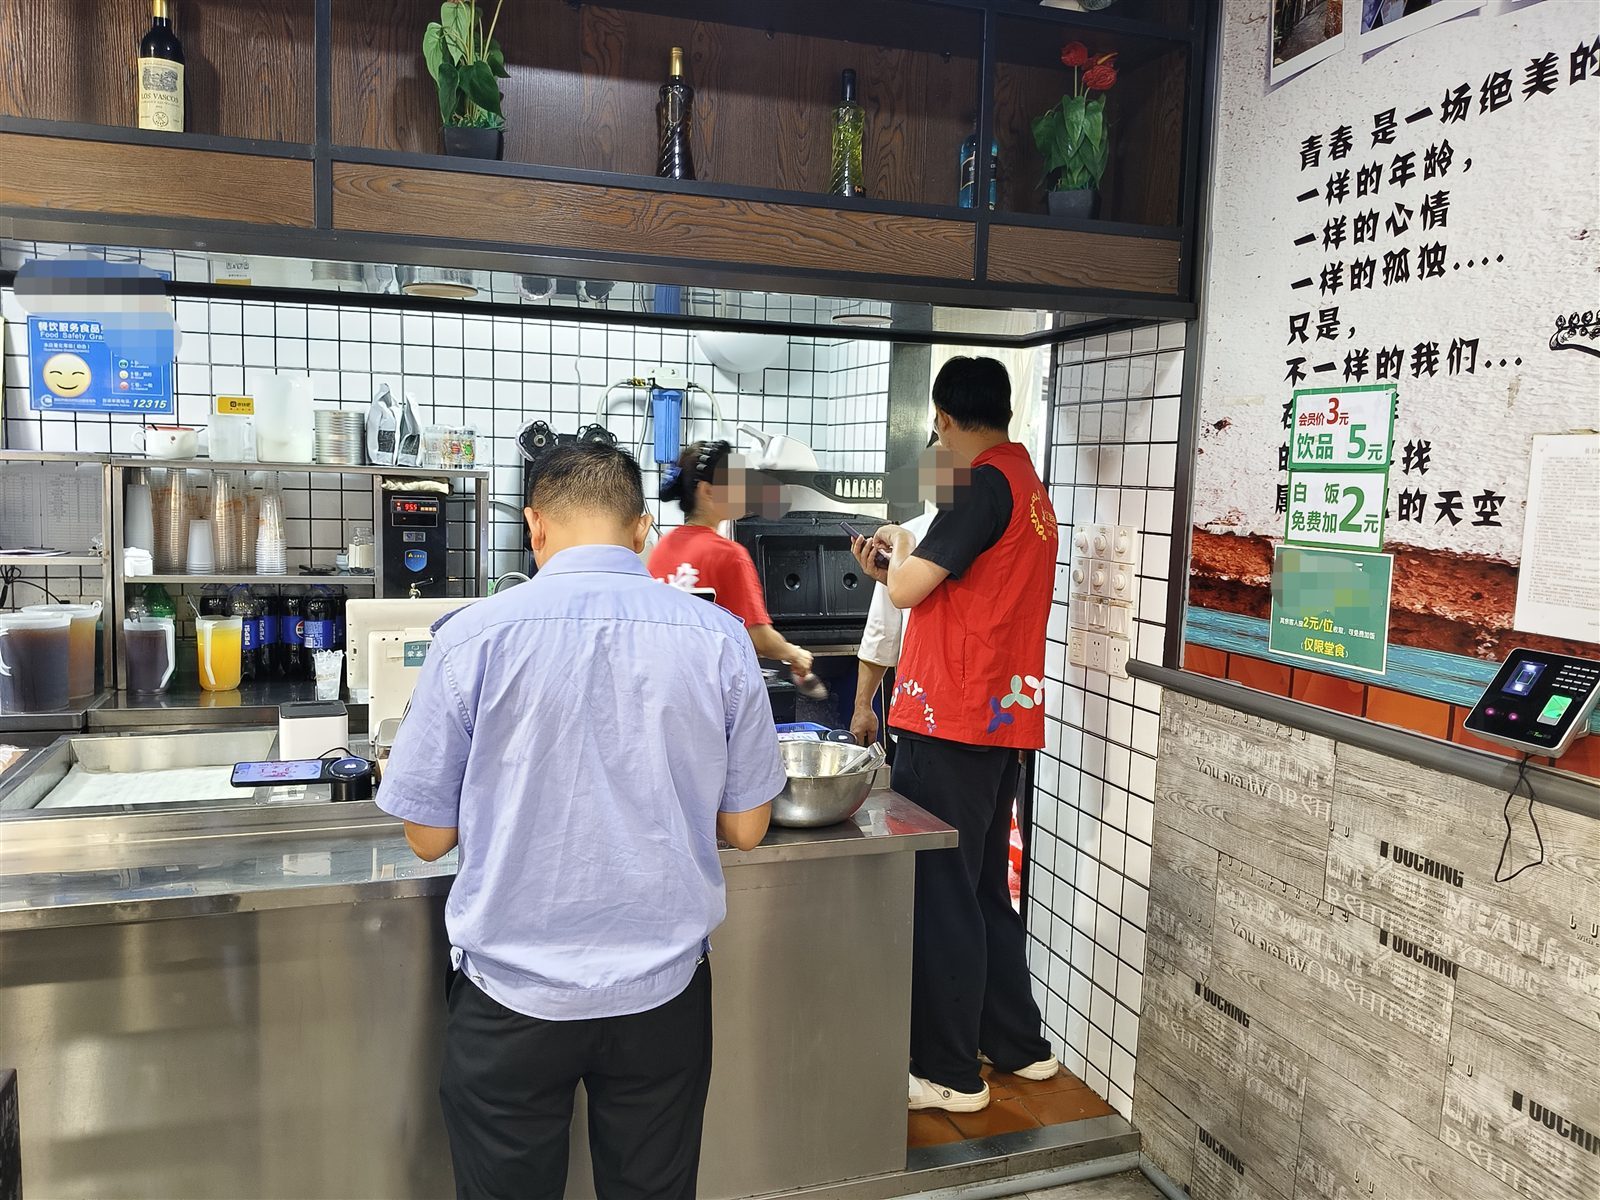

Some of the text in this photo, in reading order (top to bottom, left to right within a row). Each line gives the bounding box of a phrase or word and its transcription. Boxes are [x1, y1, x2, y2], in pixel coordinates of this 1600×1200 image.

[153, 93, 179, 104] VASCOS
[1299, 36, 1600, 171] 青春 是一场绝美的
[1294, 190, 1451, 251] 一样的心情
[38, 321, 104, 334] 餐饮服务食品
[62, 332, 86, 341] Safety
[132, 399, 168, 409] 12315
[1297, 433, 1333, 460] 饮品
[1347, 424, 1383, 461] 5元
[1196, 756, 1219, 779] You
[1229, 917, 1255, 945] You
